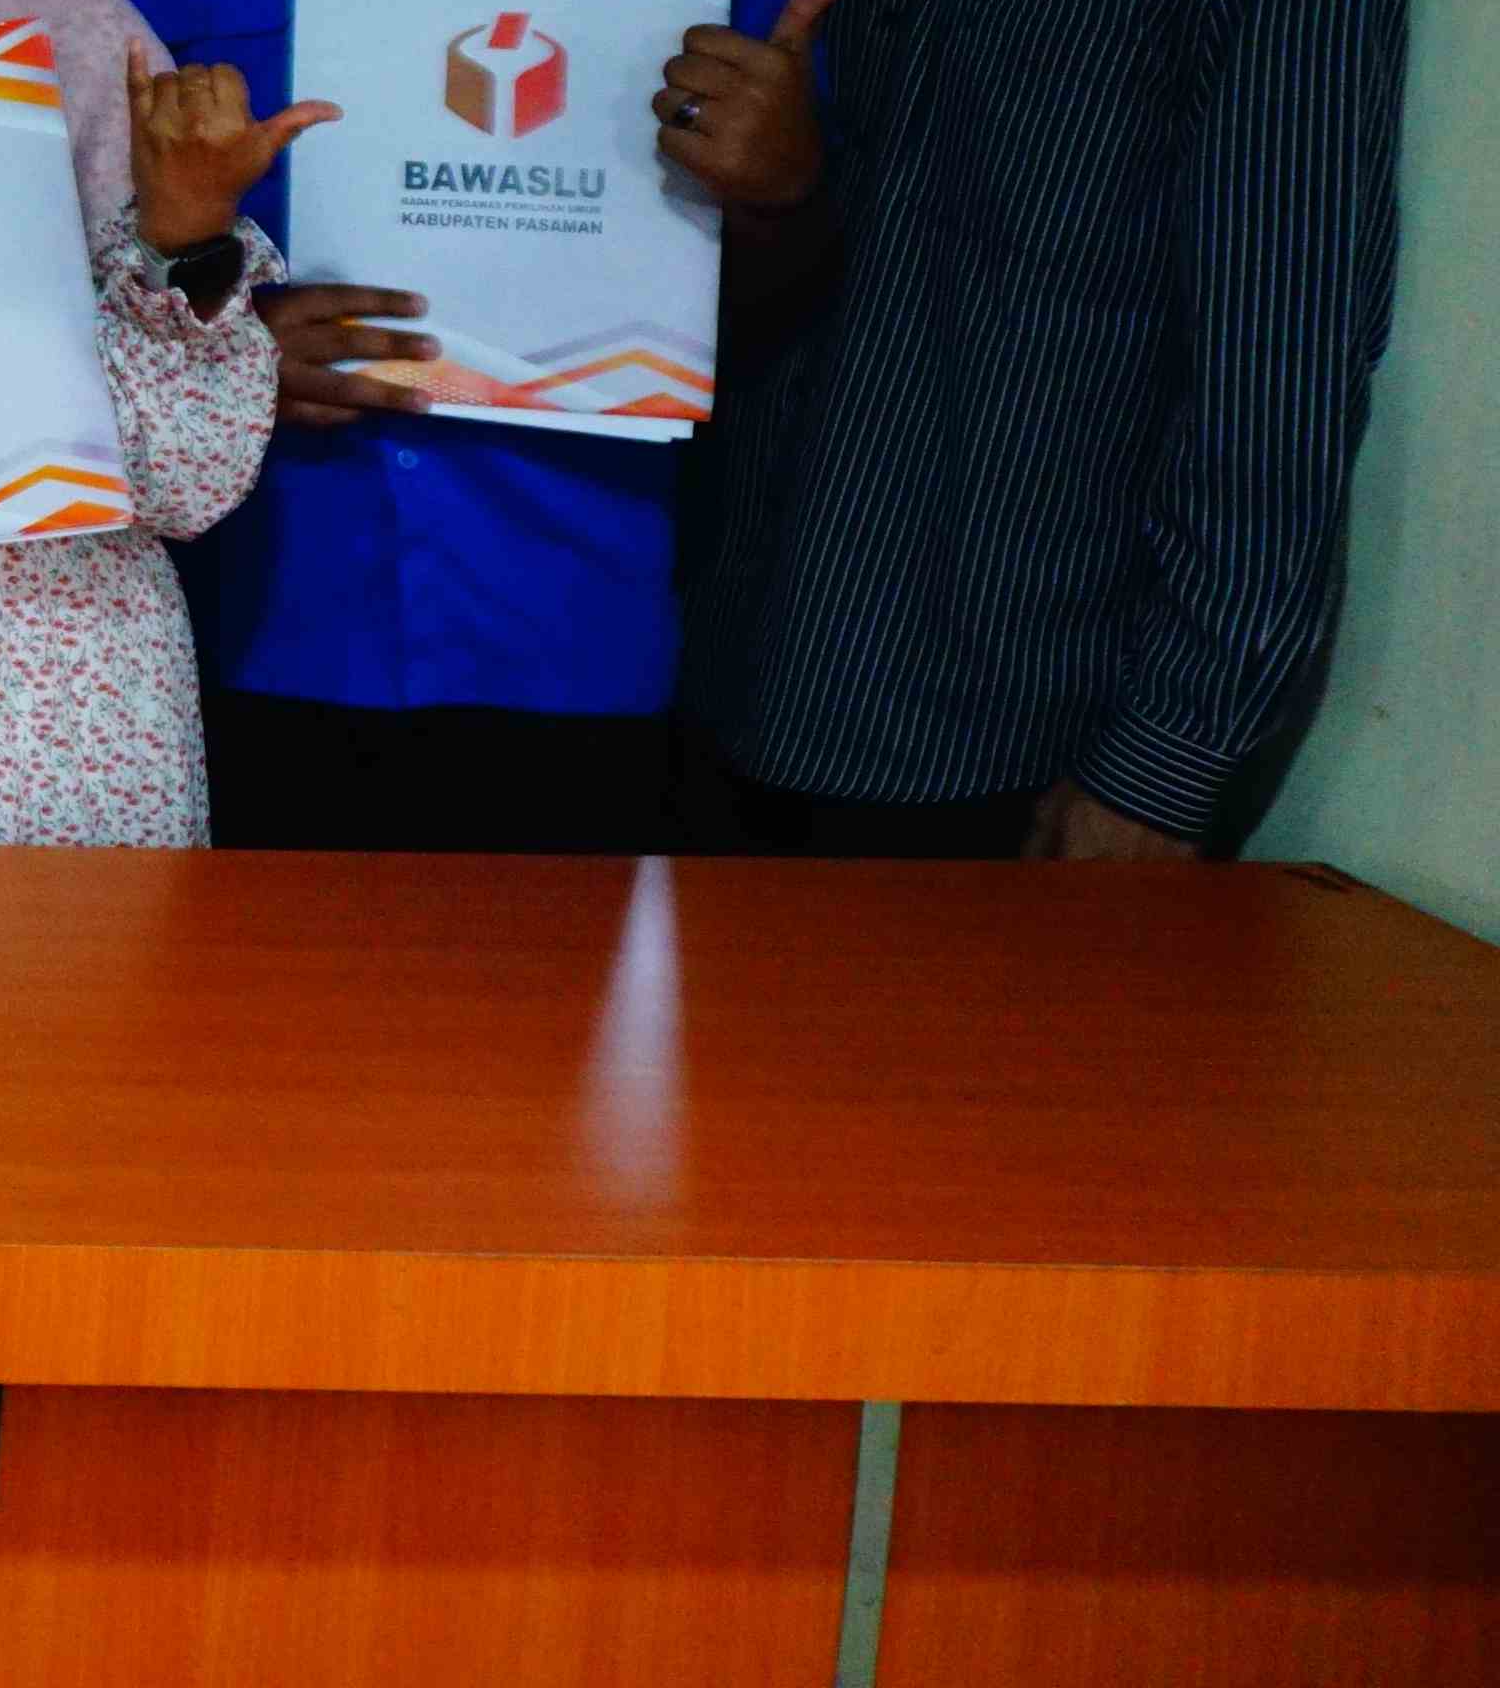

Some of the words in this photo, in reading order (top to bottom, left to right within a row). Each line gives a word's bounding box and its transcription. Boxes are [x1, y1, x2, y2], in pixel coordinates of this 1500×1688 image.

[404, 160, 606, 199] BAWASLU
[401, 211, 509, 230] KABUPATEN
[515, 217, 603, 234] PASAMAN
